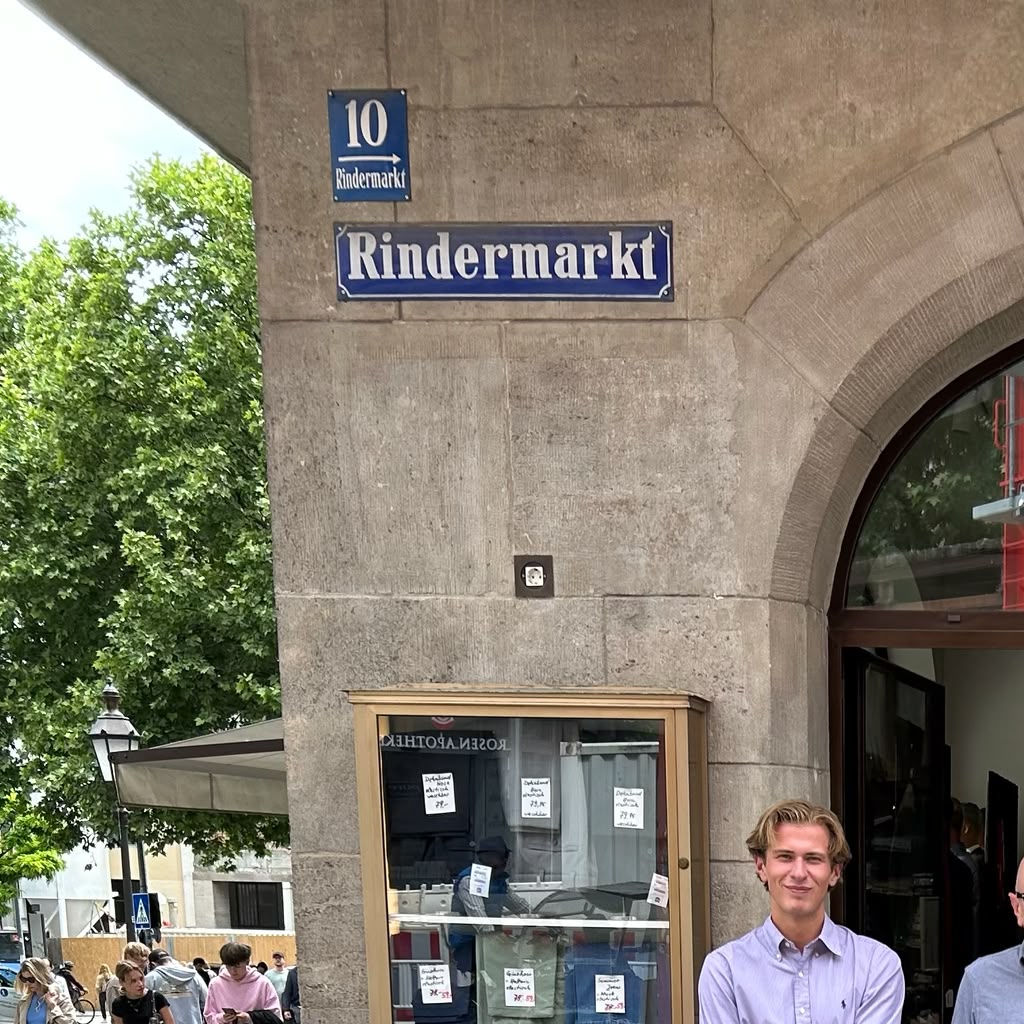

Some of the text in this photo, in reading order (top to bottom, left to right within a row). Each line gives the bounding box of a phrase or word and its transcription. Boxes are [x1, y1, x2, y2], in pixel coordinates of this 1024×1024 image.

[345, 99, 388, 148] 10
[335, 166, 406, 190] Rindermarkt
[347, 230, 657, 281] Rindermarkt
